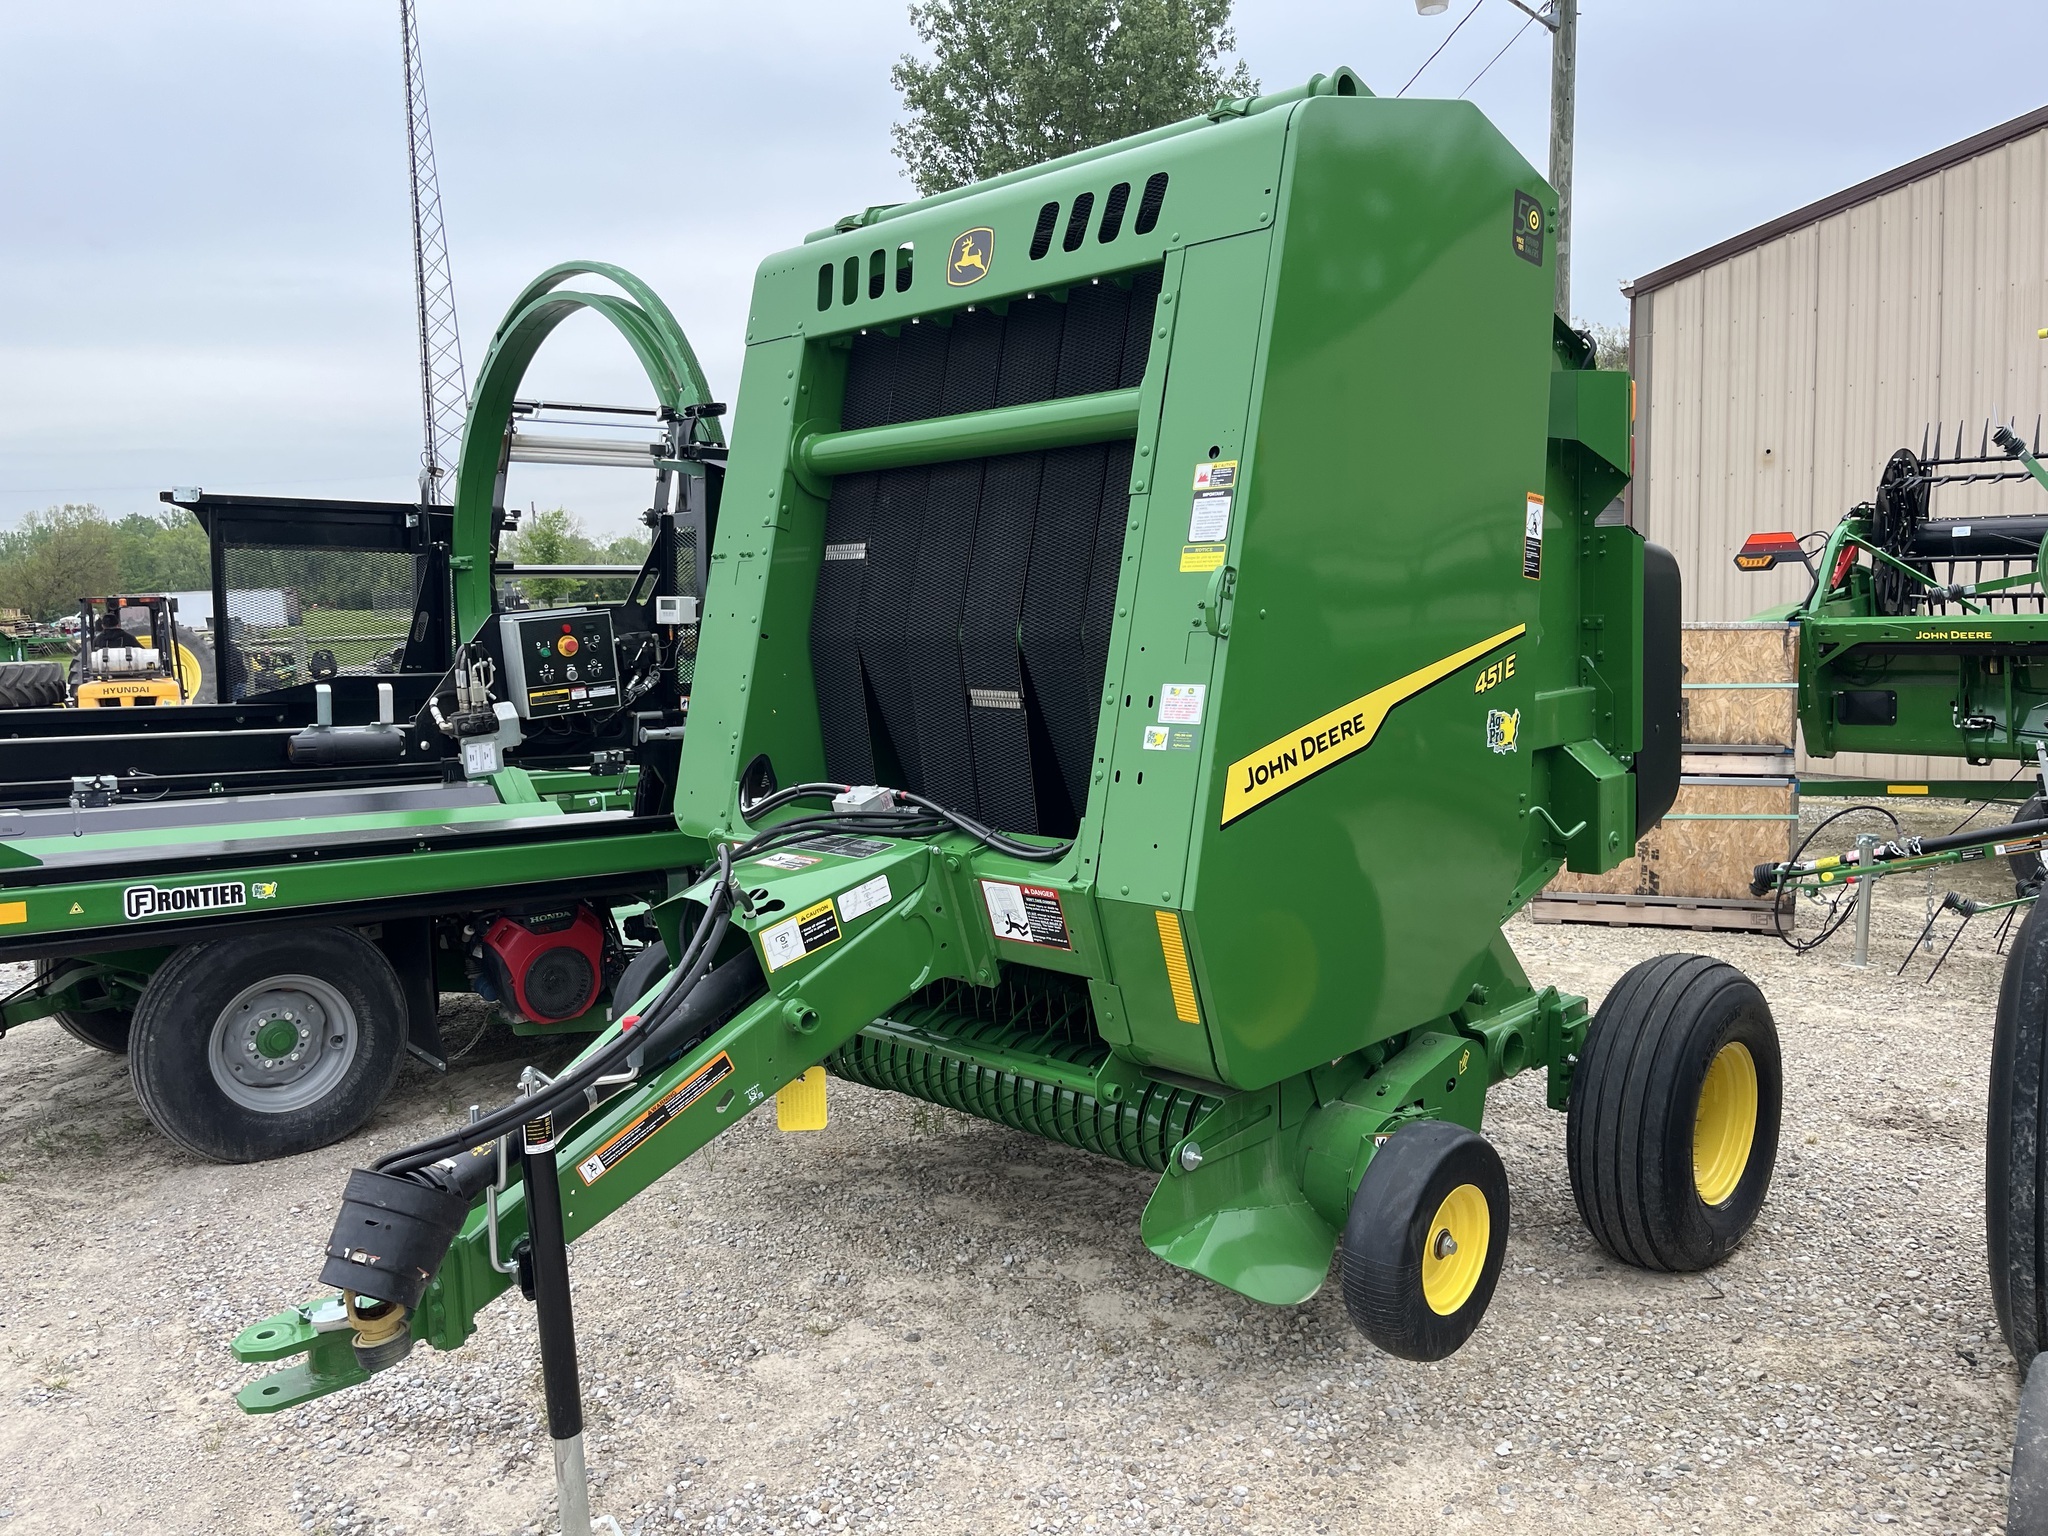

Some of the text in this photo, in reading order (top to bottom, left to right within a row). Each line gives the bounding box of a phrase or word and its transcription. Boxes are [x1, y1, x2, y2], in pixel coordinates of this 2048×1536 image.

[1916, 630, 1992, 640] JOHN DEERE
[102, 686, 150, 695] HYUNDAI
[1489, 729, 1505, 744] Pro
[1244, 713, 1365, 793] JOHN DEERE
[127, 884, 243, 917] FRONTIER
[1030, 889, 1055, 898] DANGER
[530, 911, 571, 924] HONDA
[806, 905, 829, 919] CAUTION
[651, 1091, 677, 1113] WARNING
